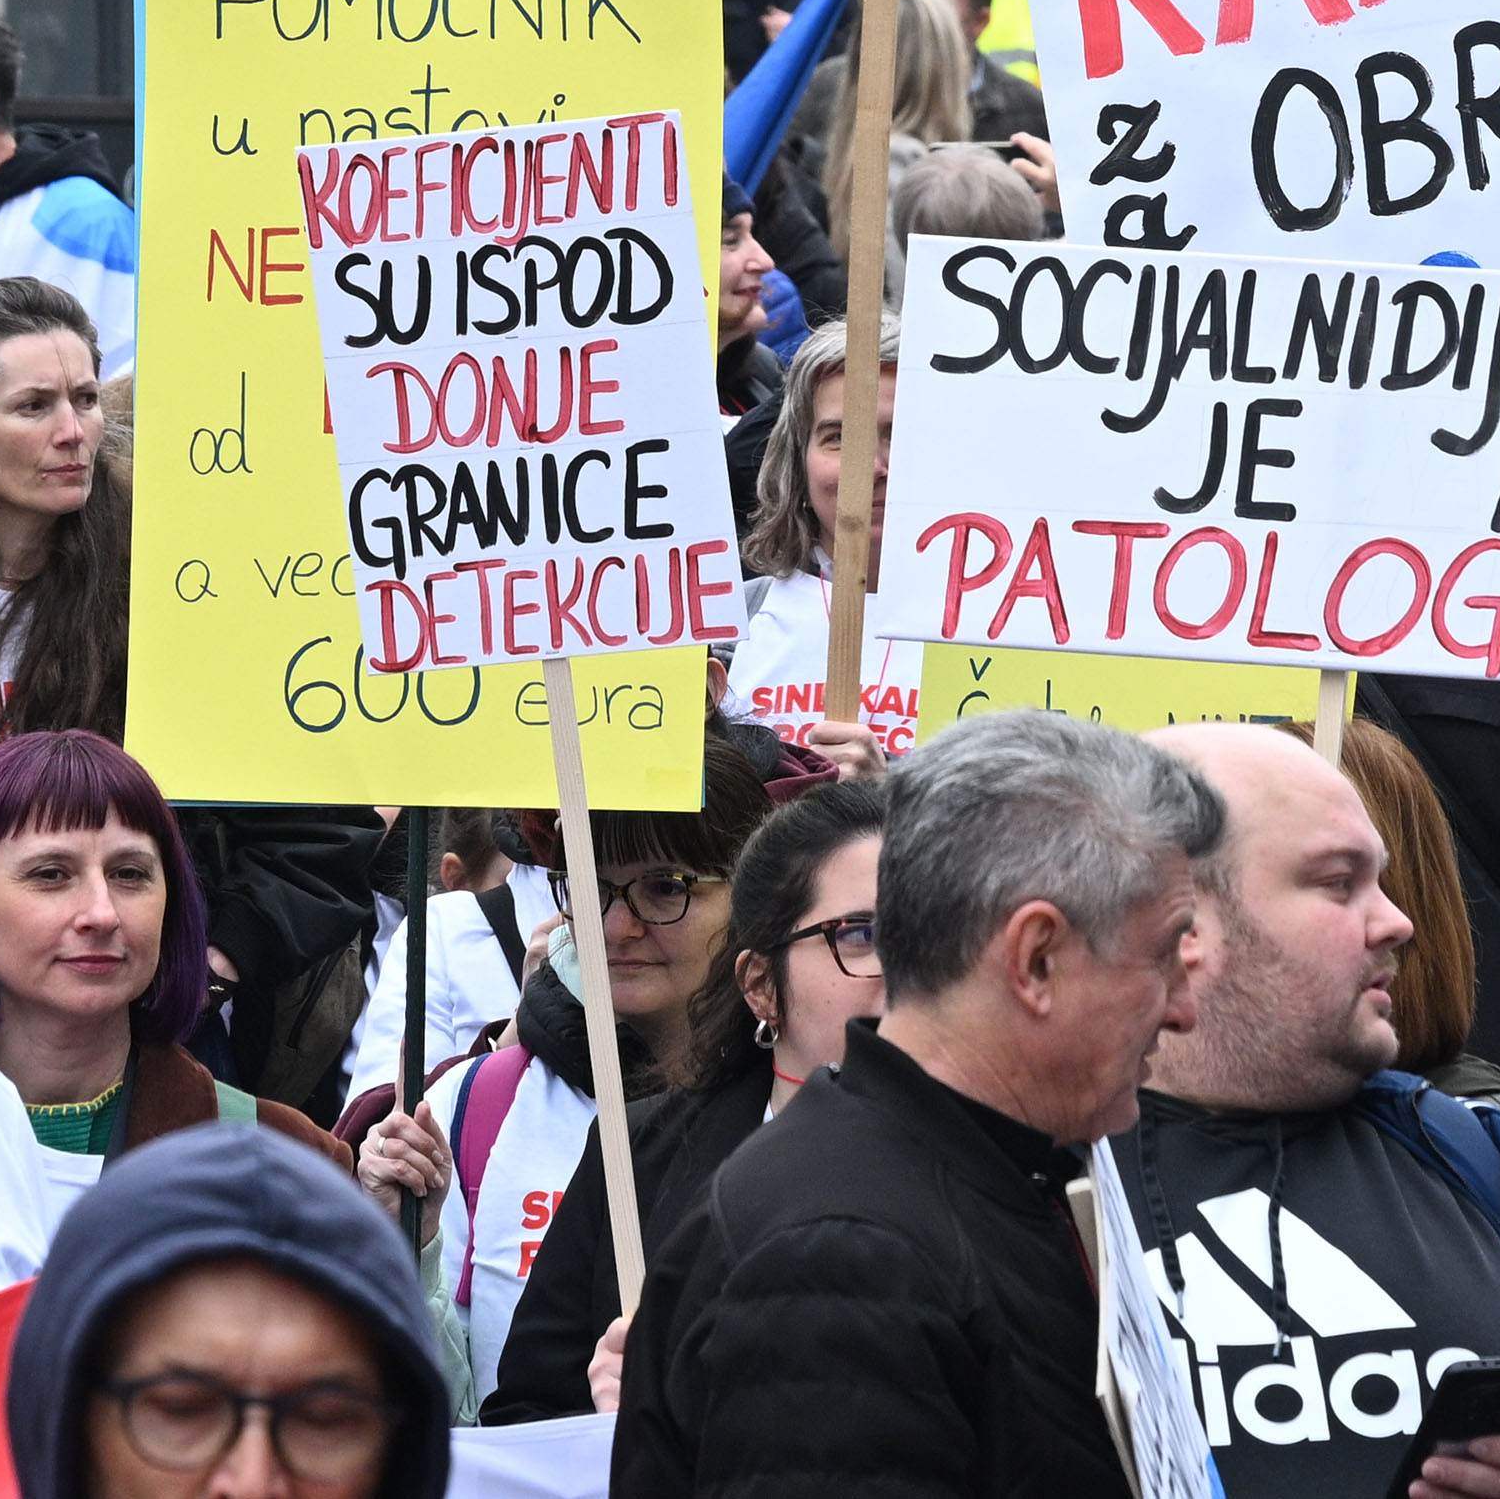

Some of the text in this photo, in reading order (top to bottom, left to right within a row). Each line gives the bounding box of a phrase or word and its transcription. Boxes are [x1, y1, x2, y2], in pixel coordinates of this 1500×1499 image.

[211, 114, 258, 156] u
[297, 112, 678, 250] KOEFICIJENTI
[335, 227, 675, 349] SU ISPOD
[189, 371, 253, 475] od
[365, 337, 626, 455] DONJE
[348, 439, 676, 580] GRANICE
[1152, 398, 1303, 522] JE
[176, 558, 218, 603] a
[364, 539, 741, 675] DETEKCIJE
